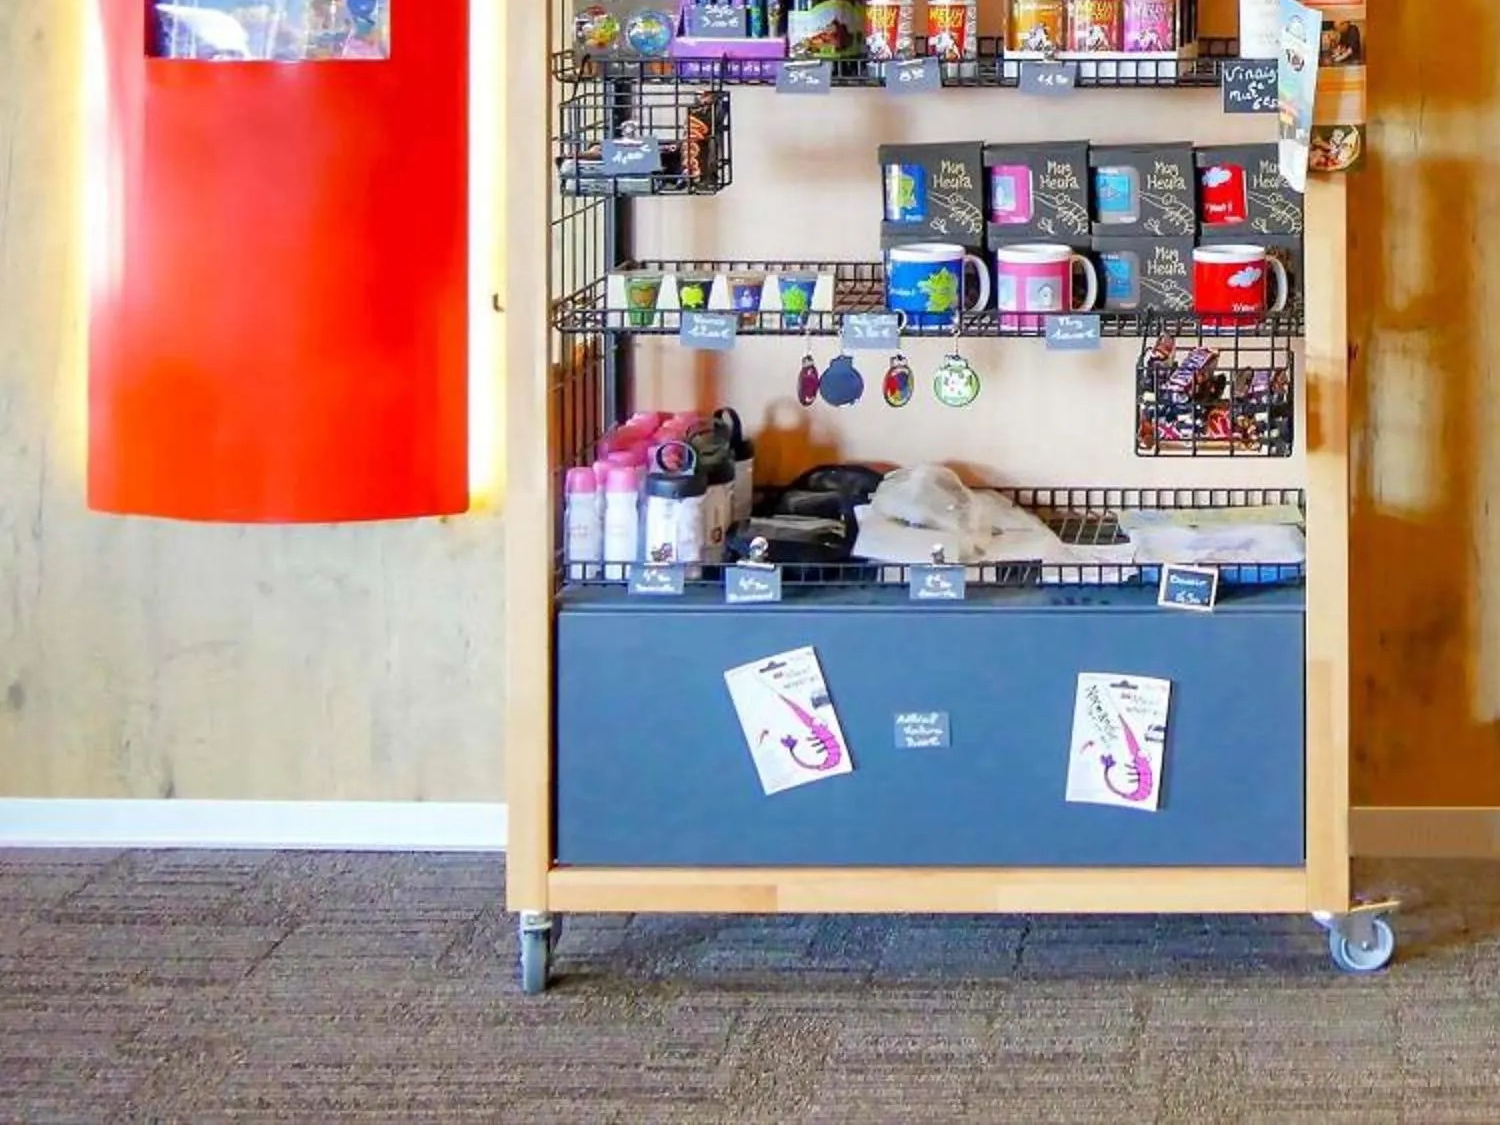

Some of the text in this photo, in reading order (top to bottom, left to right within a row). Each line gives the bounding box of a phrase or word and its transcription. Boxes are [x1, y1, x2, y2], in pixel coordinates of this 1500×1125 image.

[1225, 65, 1277, 83] Vinaig
[1253, 96, 1279, 110] 6€5
[941, 159, 965, 176] Mug
[1047, 161, 1073, 178] Mug
[1154, 160, 1179, 179] Mug
[1259, 160, 1279, 176] Mu
[1154, 246, 1179, 262] Mug
